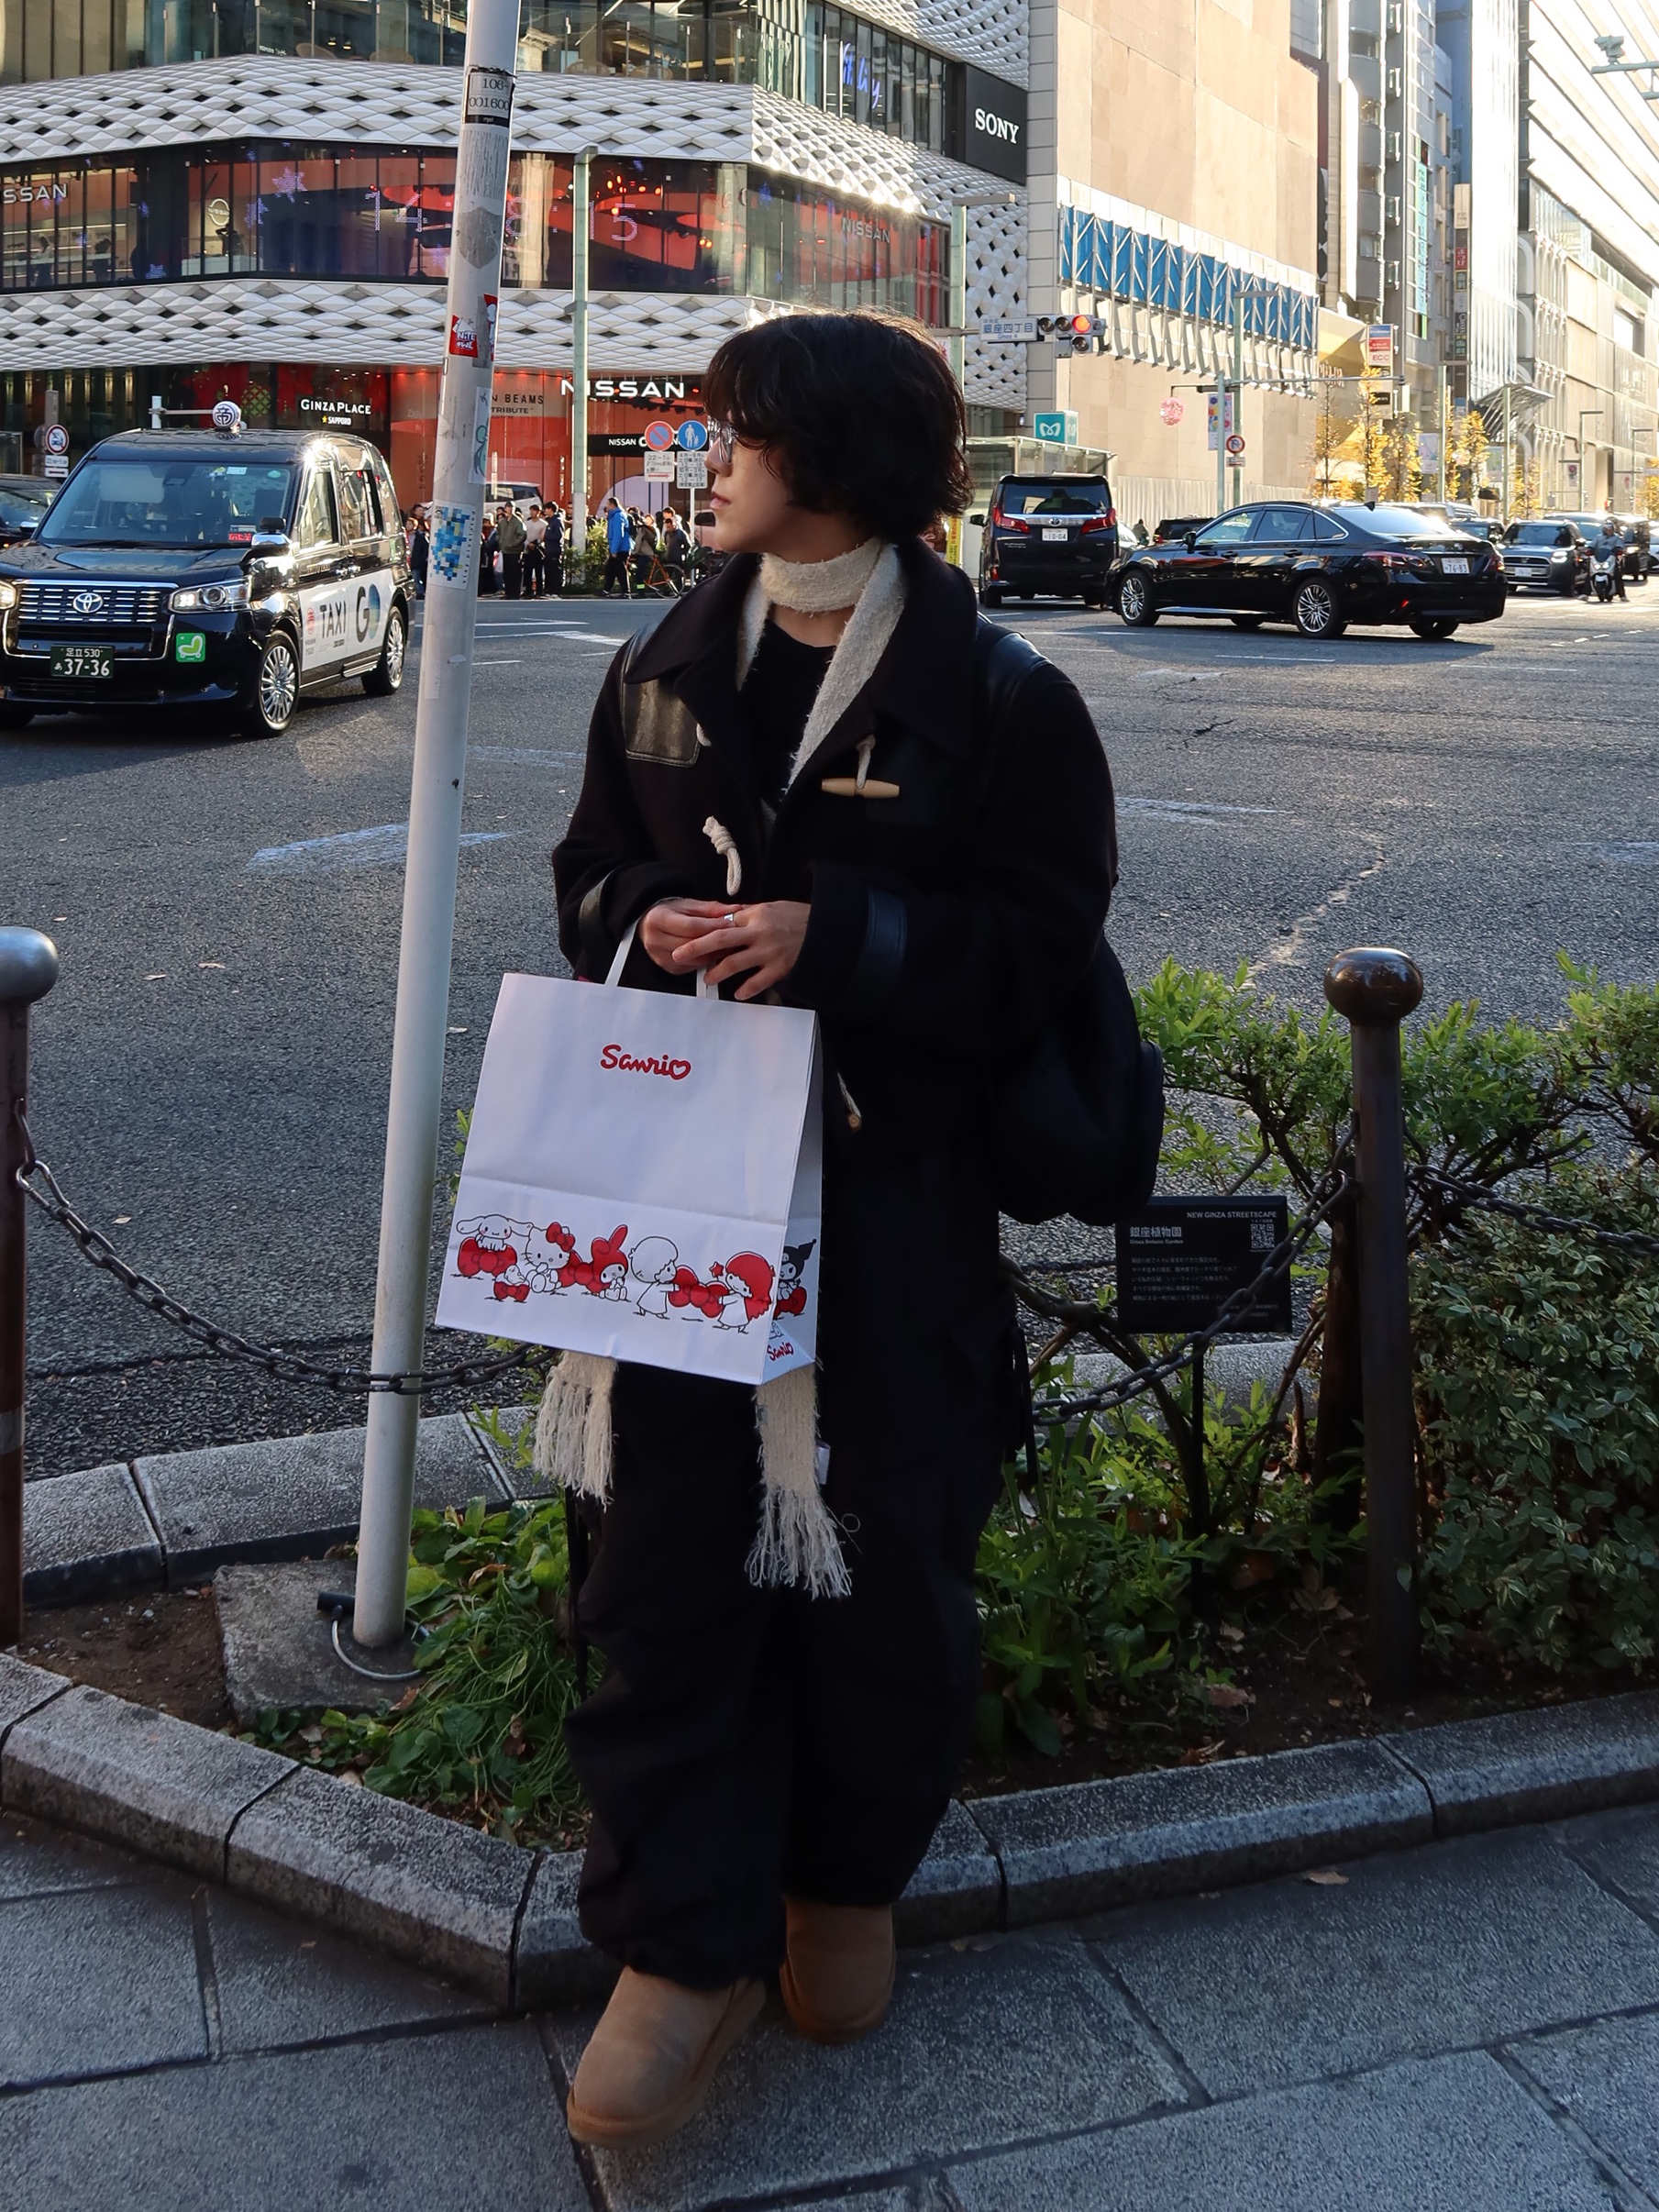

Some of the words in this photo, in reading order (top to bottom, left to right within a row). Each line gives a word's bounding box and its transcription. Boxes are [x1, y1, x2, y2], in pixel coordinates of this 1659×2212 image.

[975, 108, 1020, 144] SONY
[842, 216, 890, 244] NISSAN
[983, 322, 1034, 334] 銀座四丁目
[300, 398, 336, 413] GINZA
[337, 402, 371, 415] PLACE
[504, 393, 544, 404] BEAMS
[327, 415, 352, 426] SAPPORO
[608, 438, 636, 447] NISSAN
[319, 601, 347, 639] TAXI
[356, 583, 381, 643] GO
[64, 658, 110, 676] 37-36
[600, 1044, 691, 1080] Sanrio
[1130, 1226, 1182, 1237] 銀座植物園
[767, 1341, 794, 1361] Sanrio
